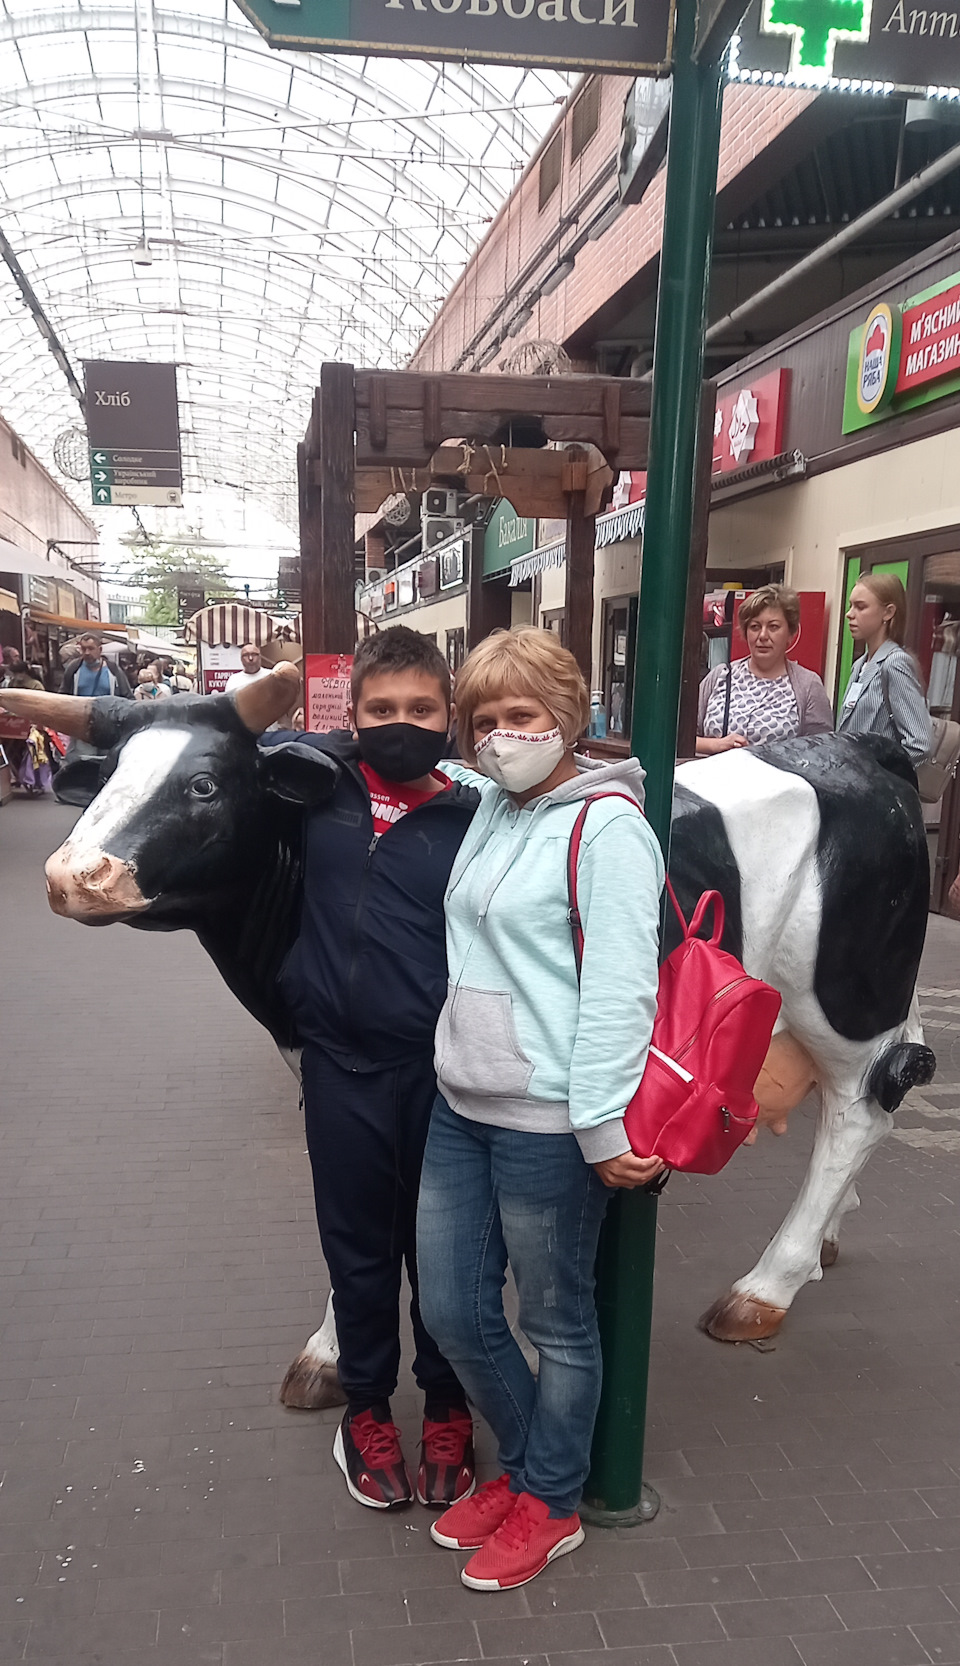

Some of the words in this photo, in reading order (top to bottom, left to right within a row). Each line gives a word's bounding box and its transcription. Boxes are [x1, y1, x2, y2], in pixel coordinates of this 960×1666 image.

[385, 0, 639, 27] васи
[881, 0, 960, 38] Апт
[864, 355, 882, 372] НАША
[863, 370, 880, 388] РЯБА
[95, 391, 131, 407] Хліб
[114, 491, 138, 500] Метро
